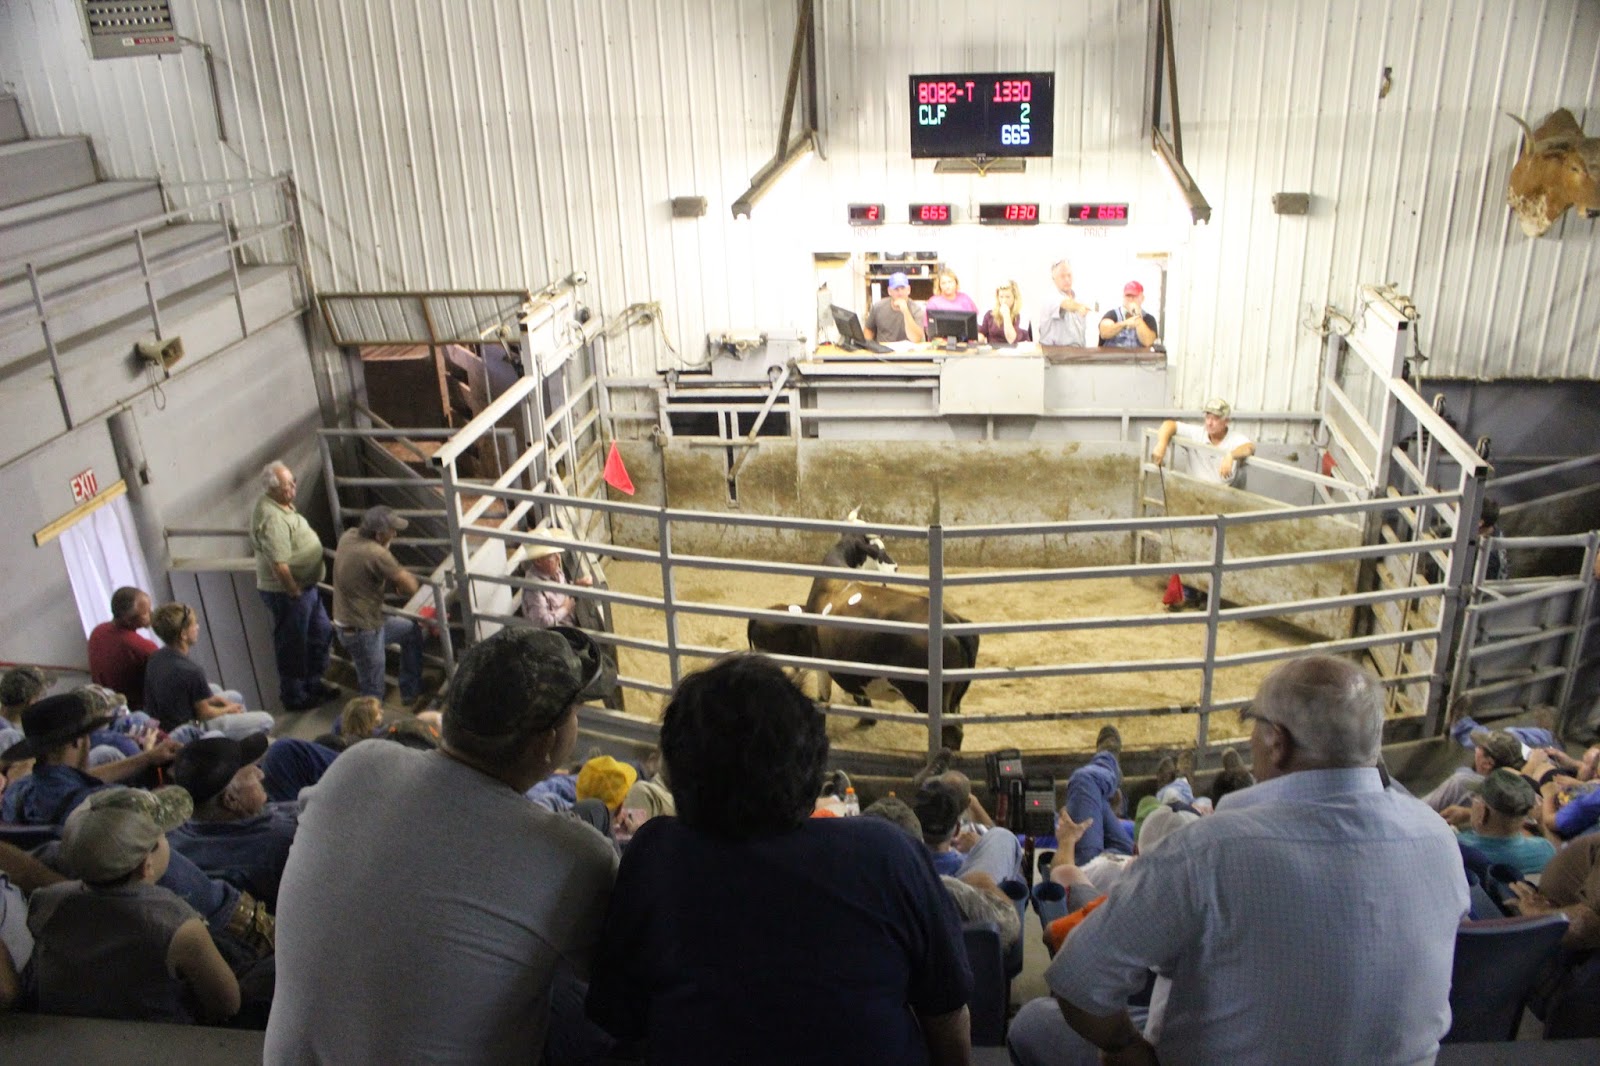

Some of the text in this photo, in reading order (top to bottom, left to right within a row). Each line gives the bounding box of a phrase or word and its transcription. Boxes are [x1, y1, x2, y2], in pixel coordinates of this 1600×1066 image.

[918, 81, 1031, 103] 8082-T 1330
[919, 103, 1030, 125] CLF 2
[1001, 124, 1030, 144] 665
[868, 205, 878, 220] 2
[921, 205, 948, 220] 665
[1005, 205, 1036, 220] 1330
[1080, 205, 1091, 220] 2
[71, 469, 97, 502] EXIT
